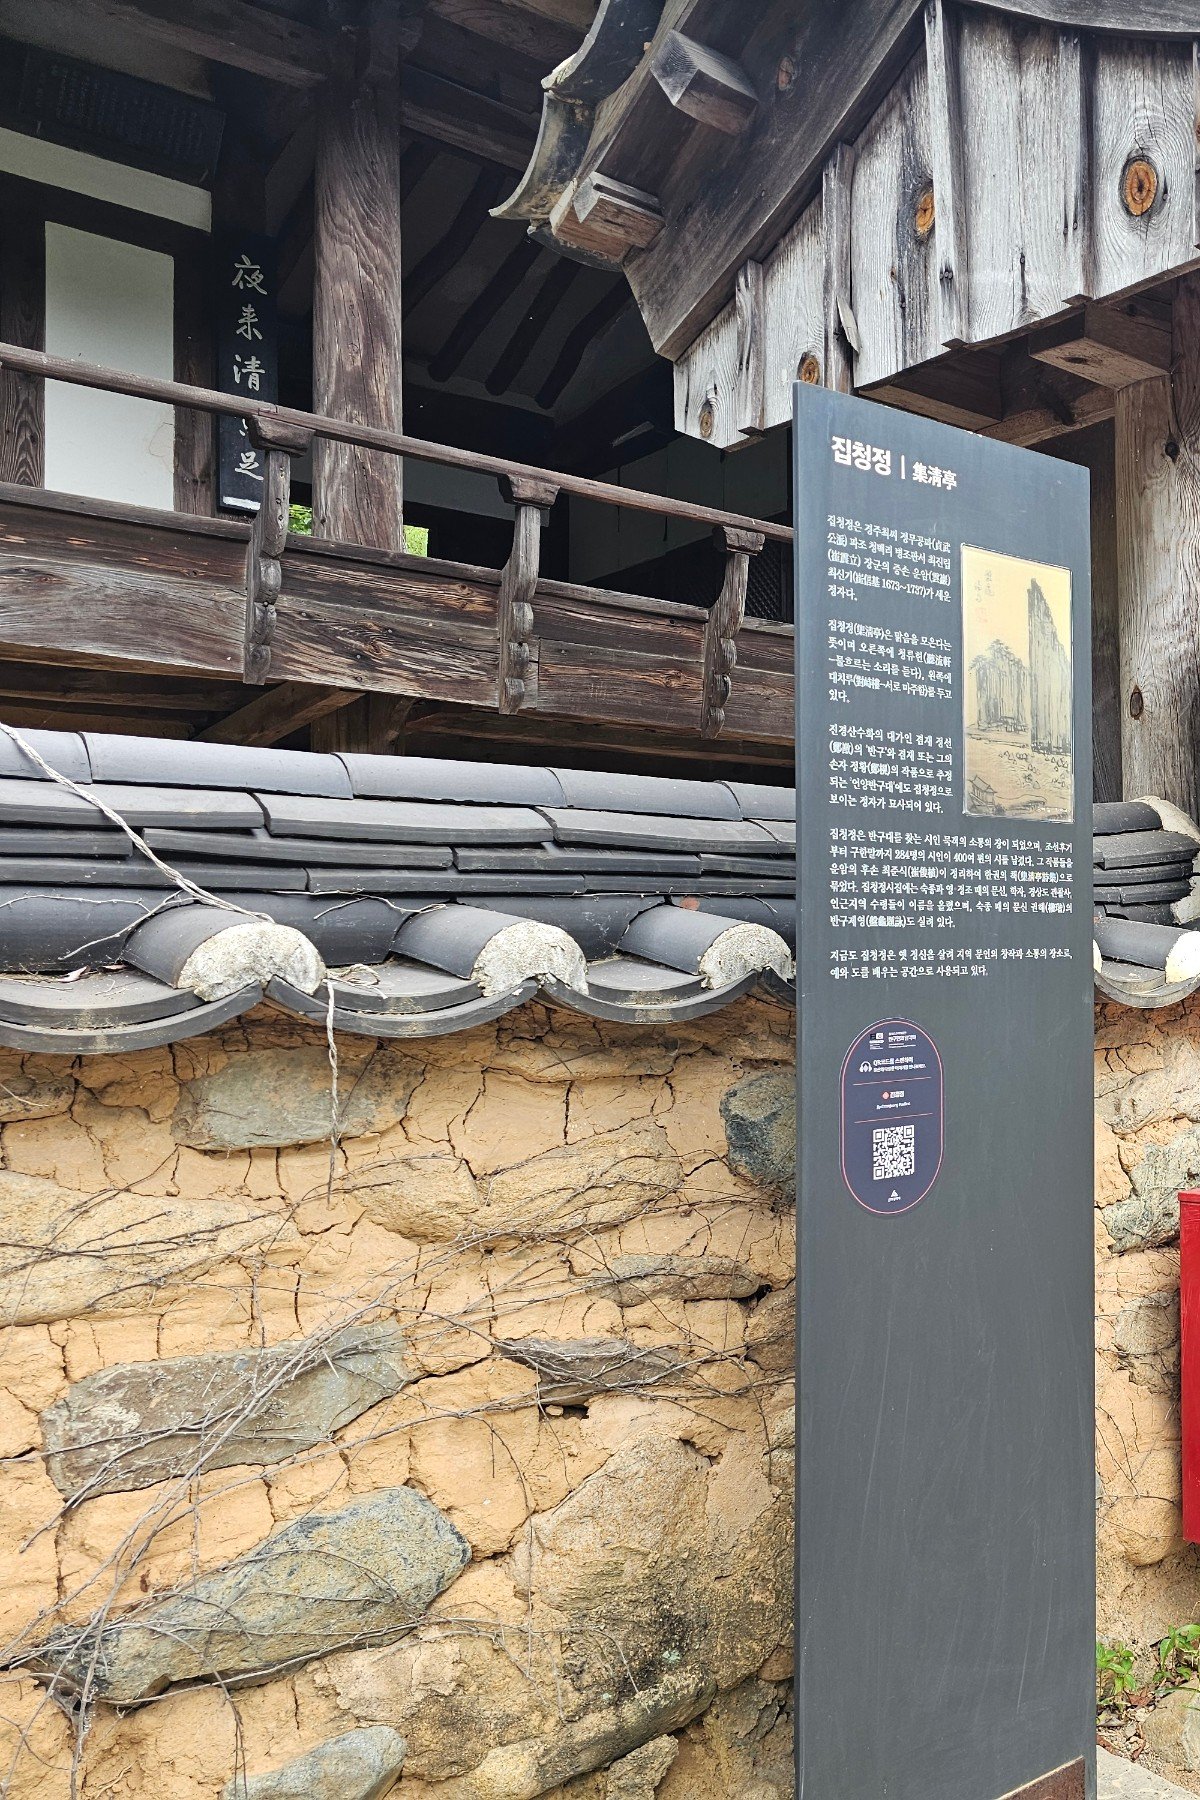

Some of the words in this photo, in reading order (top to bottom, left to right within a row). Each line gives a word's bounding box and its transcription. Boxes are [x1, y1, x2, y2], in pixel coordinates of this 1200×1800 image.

[831, 436, 892, 476] 집청정
[826, 514, 863, 532] 집청정은
[863, 523, 898, 541] 경주최씨
[849, 537, 868, 549] 파조
[868, 541, 892, 557] 청백리
[894, 547, 926, 564] 병조판서
[927, 554, 951, 569] 최진립
[863, 557, 890, 573] 장군의
[892, 563, 910, 577] 증손
[827, 584, 858, 601] 정자다.
[934, 589, 952, 602] 세운
[827, 636, 856, 652] 뜻이며
[858, 642, 894, 658] 오른쪽에
[893, 631, 919, 645] 맑음을
[919, 636, 952, 651] 모은다는
[873, 661, 900, 675] 소리를
[927, 670, 952, 684] 왼쪽에
[828, 688, 851, 703] 있다.
[936, 687, 952, 699] 두고
[828, 723, 883, 741] 진경산수화의
[886, 730, 913, 744] 대가인
[915, 733, 933, 747] 겸재
[935, 736, 952, 749] 정선
[897, 748, 915, 761] 겸재
[916, 751, 935, 763] 또는
[935, 753, 952, 765] 그의
[828, 758, 849, 771] 손자
[900, 765, 934, 778] 작품으로
[935, 769, 952, 781] 추정
[829, 775, 848, 788] 되는
[912, 783, 954, 796] 집청정으로
[828, 793, 858, 806] 보이는
[859, 795, 886, 809] 정자가
[887, 798, 922, 811] 묘사되어
[924, 800, 944, 813] 있다.
[829, 827, 866, 841] 집청정은
[867, 830, 903, 843] 반구대를
[904, 832, 922, 844] 찾는
[923, 833, 941, 845] 시인
[968, 837, 992, 848] 소통의
[993, 837, 1010, 850] 장이
[1011, 839, 1042, 852] 되었으며,
[1044, 841, 1072, 853] 조선후기
[828, 845, 848, 857] 부터
[849, 846, 892, 860] 구한말까지
[894, 849, 926, 861] 284명의
[927, 850, 951, 862] 시인이
[952, 852, 975, 864] 400여
[976, 852, 992, 865] 편의
[993, 853, 1010, 865] 시를
[1010, 854, 1034, 866] 남겼다.
[1036, 857, 1044, 865] 그
[1044, 856, 1074, 868] 작품들을
[828, 862, 857, 875] 운암의
[859, 863, 880, 876] 후손
[949, 867, 982, 880] 정리하여
[983, 869, 1007, 881] 한권의
[829, 880, 859, 892] 묶었다.
[860, 881, 919, 894] 집청정시집에는
[919, 883, 945, 895] 숙종과
[1009, 885, 1026, 898] 학자,
[1027, 886, 1050, 897] 경상도
[829, 897, 867, 910] 인근지역
[869, 898, 905, 910] 수령들이
[908, 899, 935, 911] 이름을
[936, 899, 973, 912] 올렸으며,
[975, 900, 992, 912] 숙종
[1012, 899, 1029, 912] 문신
[916, 915, 934, 927] 실려
[936, 915, 956, 928] 있다.
[829, 949, 858, 961] 지금도
[860, 948, 897, 961] 집청정은
[898, 948, 908, 961] 옛
[909, 948, 936, 960] 정신을
[936, 948, 954, 960] 살려
[956, 948, 972, 960] 지역
[974, 948, 998, 959] 문인의
[999, 948, 1024, 959] 창작과
[1024, 948, 1047, 959] 소통의
[1048, 947, 1072, 959] 장소로,
[829, 966, 850, 979] 예와
[850, 966, 870, 978] 도를
[871, 966, 898, 978] 배우는
[899, 965, 934, 977] 공간으로
[935, 964, 969, 976] 사용되고
[970, 964, 988, 976] 있다.
